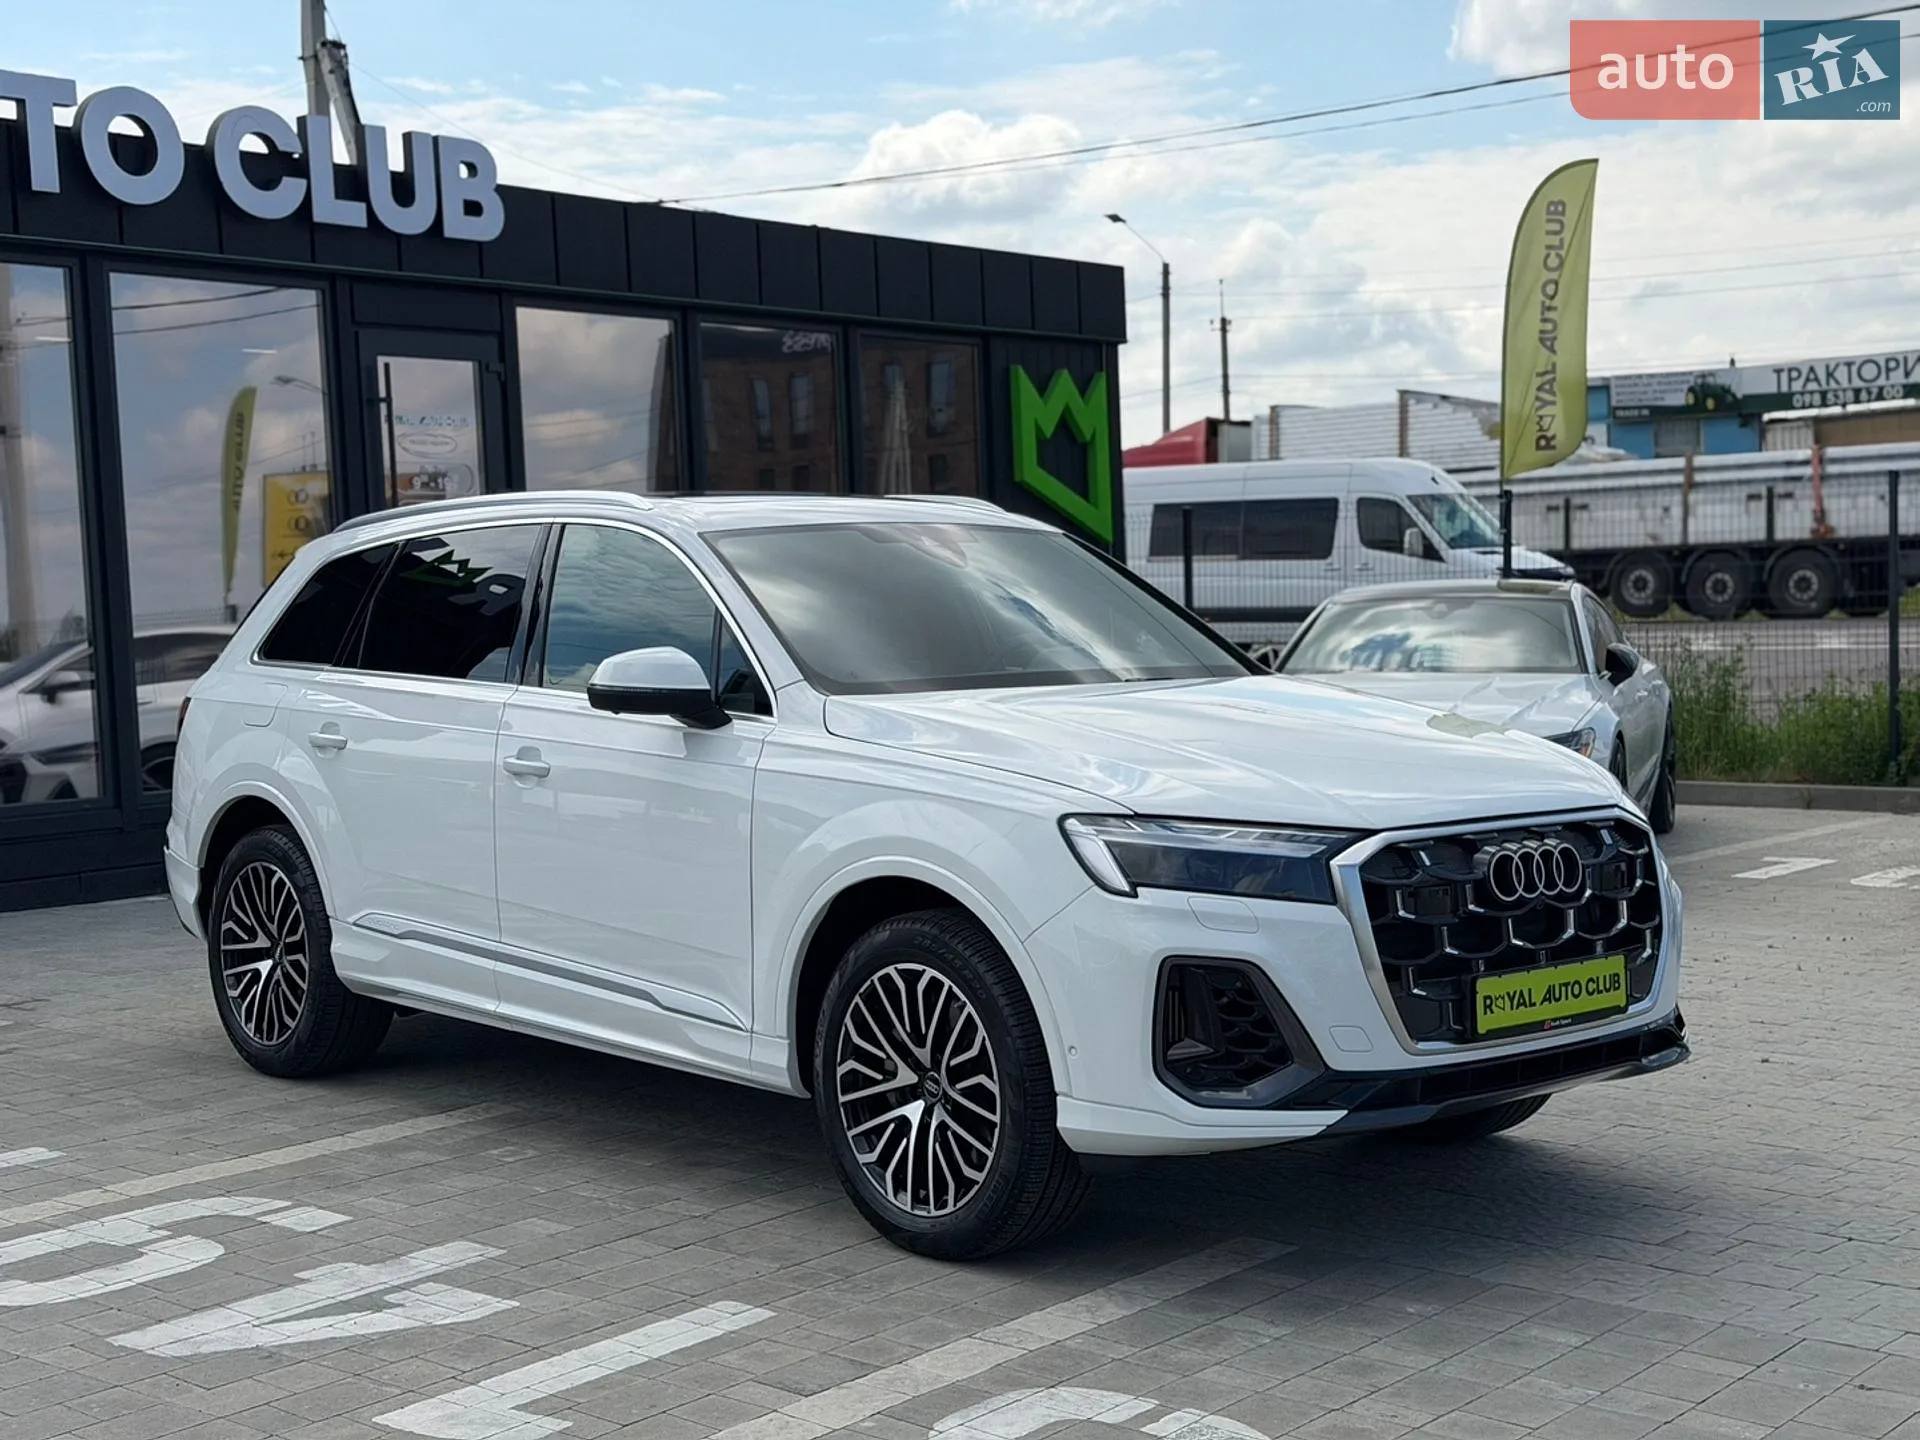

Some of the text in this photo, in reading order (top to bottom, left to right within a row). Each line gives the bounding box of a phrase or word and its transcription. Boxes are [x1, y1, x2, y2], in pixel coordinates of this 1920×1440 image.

[206, 105, 505, 242] CLUB
[1543, 199, 1566, 272] CLUB
[1538, 278, 1559, 355] AUTO
[1540, 979, 1582, 1006] AUTO
[1585, 972, 1621, 996] CLUB
